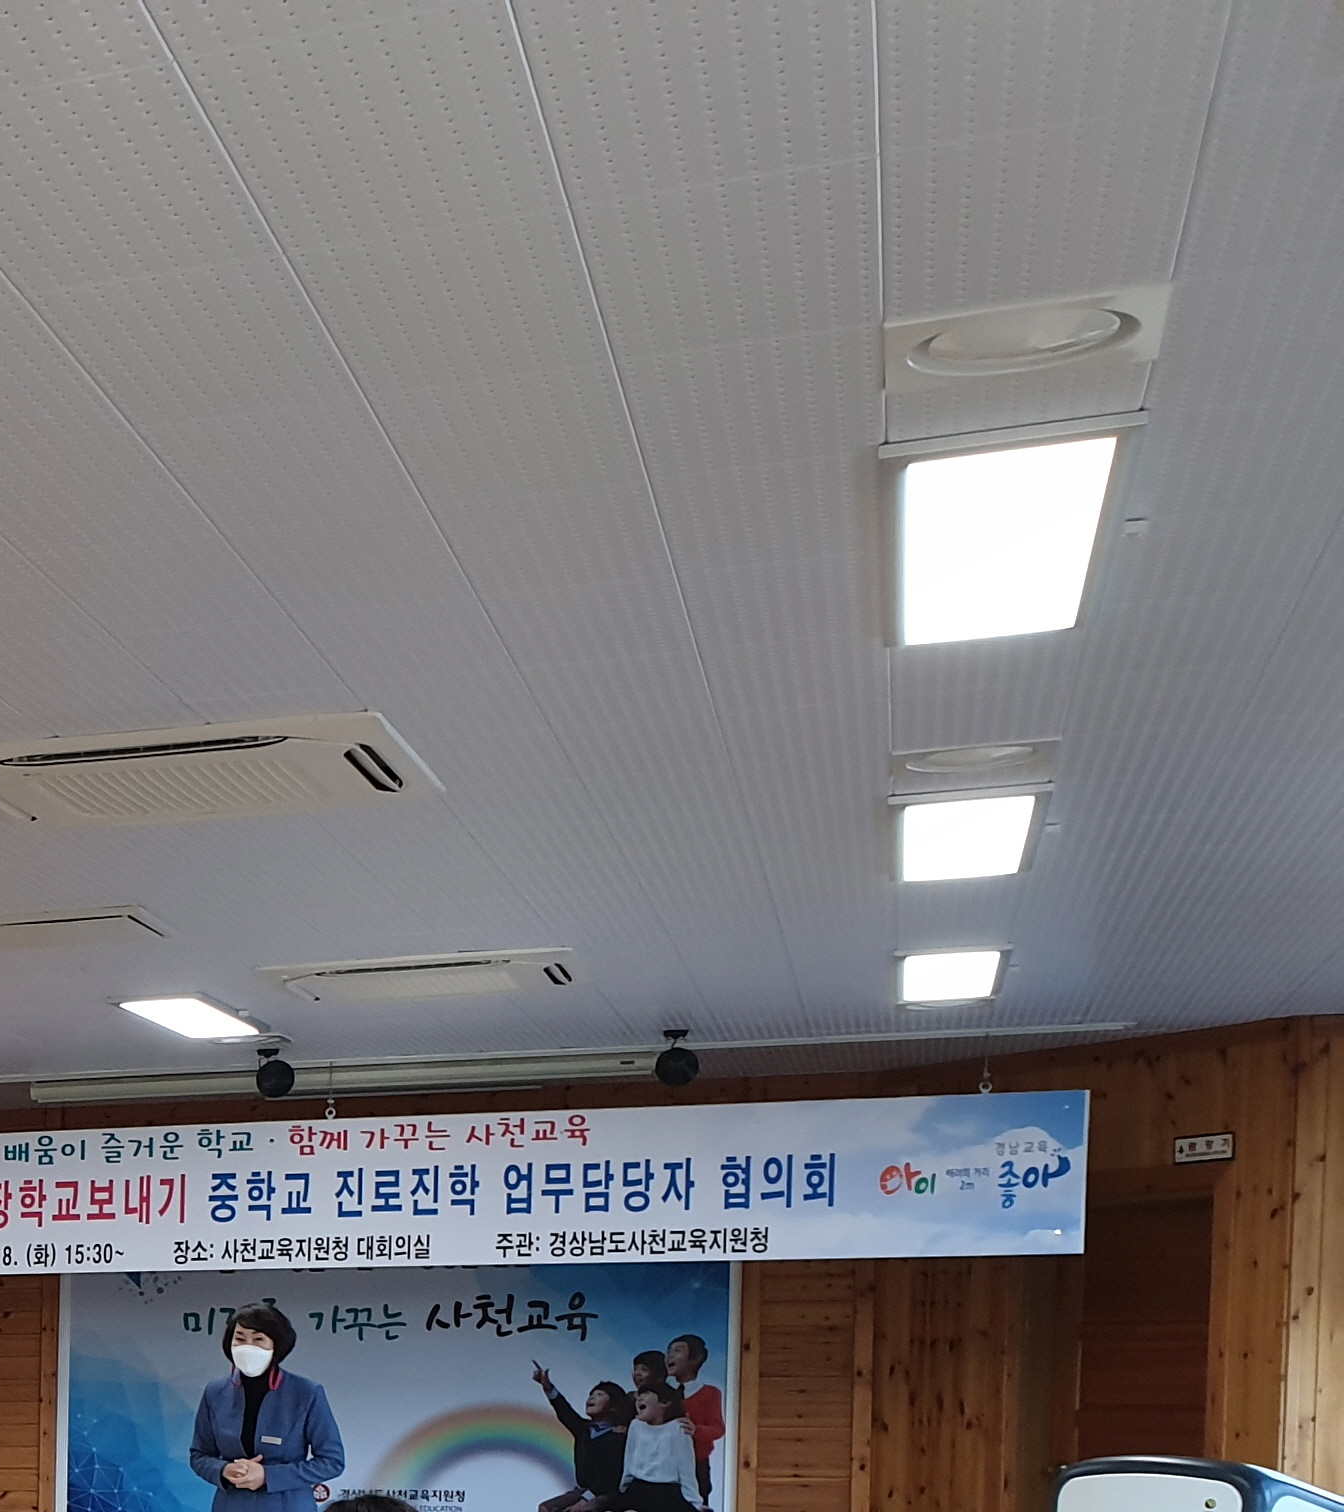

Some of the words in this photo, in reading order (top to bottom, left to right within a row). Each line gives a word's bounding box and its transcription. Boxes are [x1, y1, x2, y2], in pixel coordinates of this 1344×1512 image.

[3, 1134, 86, 1165] 배움이
[101, 1131, 184, 1164] 즐거운
[197, 1128, 255, 1159] 학교
[288, 1125, 349, 1156] 함께
[360, 1121, 451, 1151] 가꾸는
[465, 1114, 591, 1148] 사천교육
[995, 1140, 1048, 1157] 경남교육
[208, 1168, 314, 1224] 중학교
[334, 1163, 481, 1219] 진로진학
[502, 1156, 696, 1215] 업무담당자
[719, 1152, 837, 1211] 협의회
[879, 1162, 937, 1196] 아이
[959, 1180, 975, 1191] 2m
[997, 1154, 1072, 1210] 좋아
[2, 1245, 19, 1267] 8.
[26, 1242, 57, 1269] (화)
[64, 1242, 125, 1265] 15:30~
[172, 1238, 215, 1266] 장소:
[221, 1234, 350, 1264] 사천교육지원청
[357, 1233, 432, 1261] 대회의실
[495, 1231, 541, 1258] 주관:
[548, 1225, 770, 1257] 경상남도사천교육지원청
[308, 1302, 408, 1342] 가꾸는
[425, 1291, 600, 1342] 사천교육
[419, 1504, 463, 1512] EDUCATION
